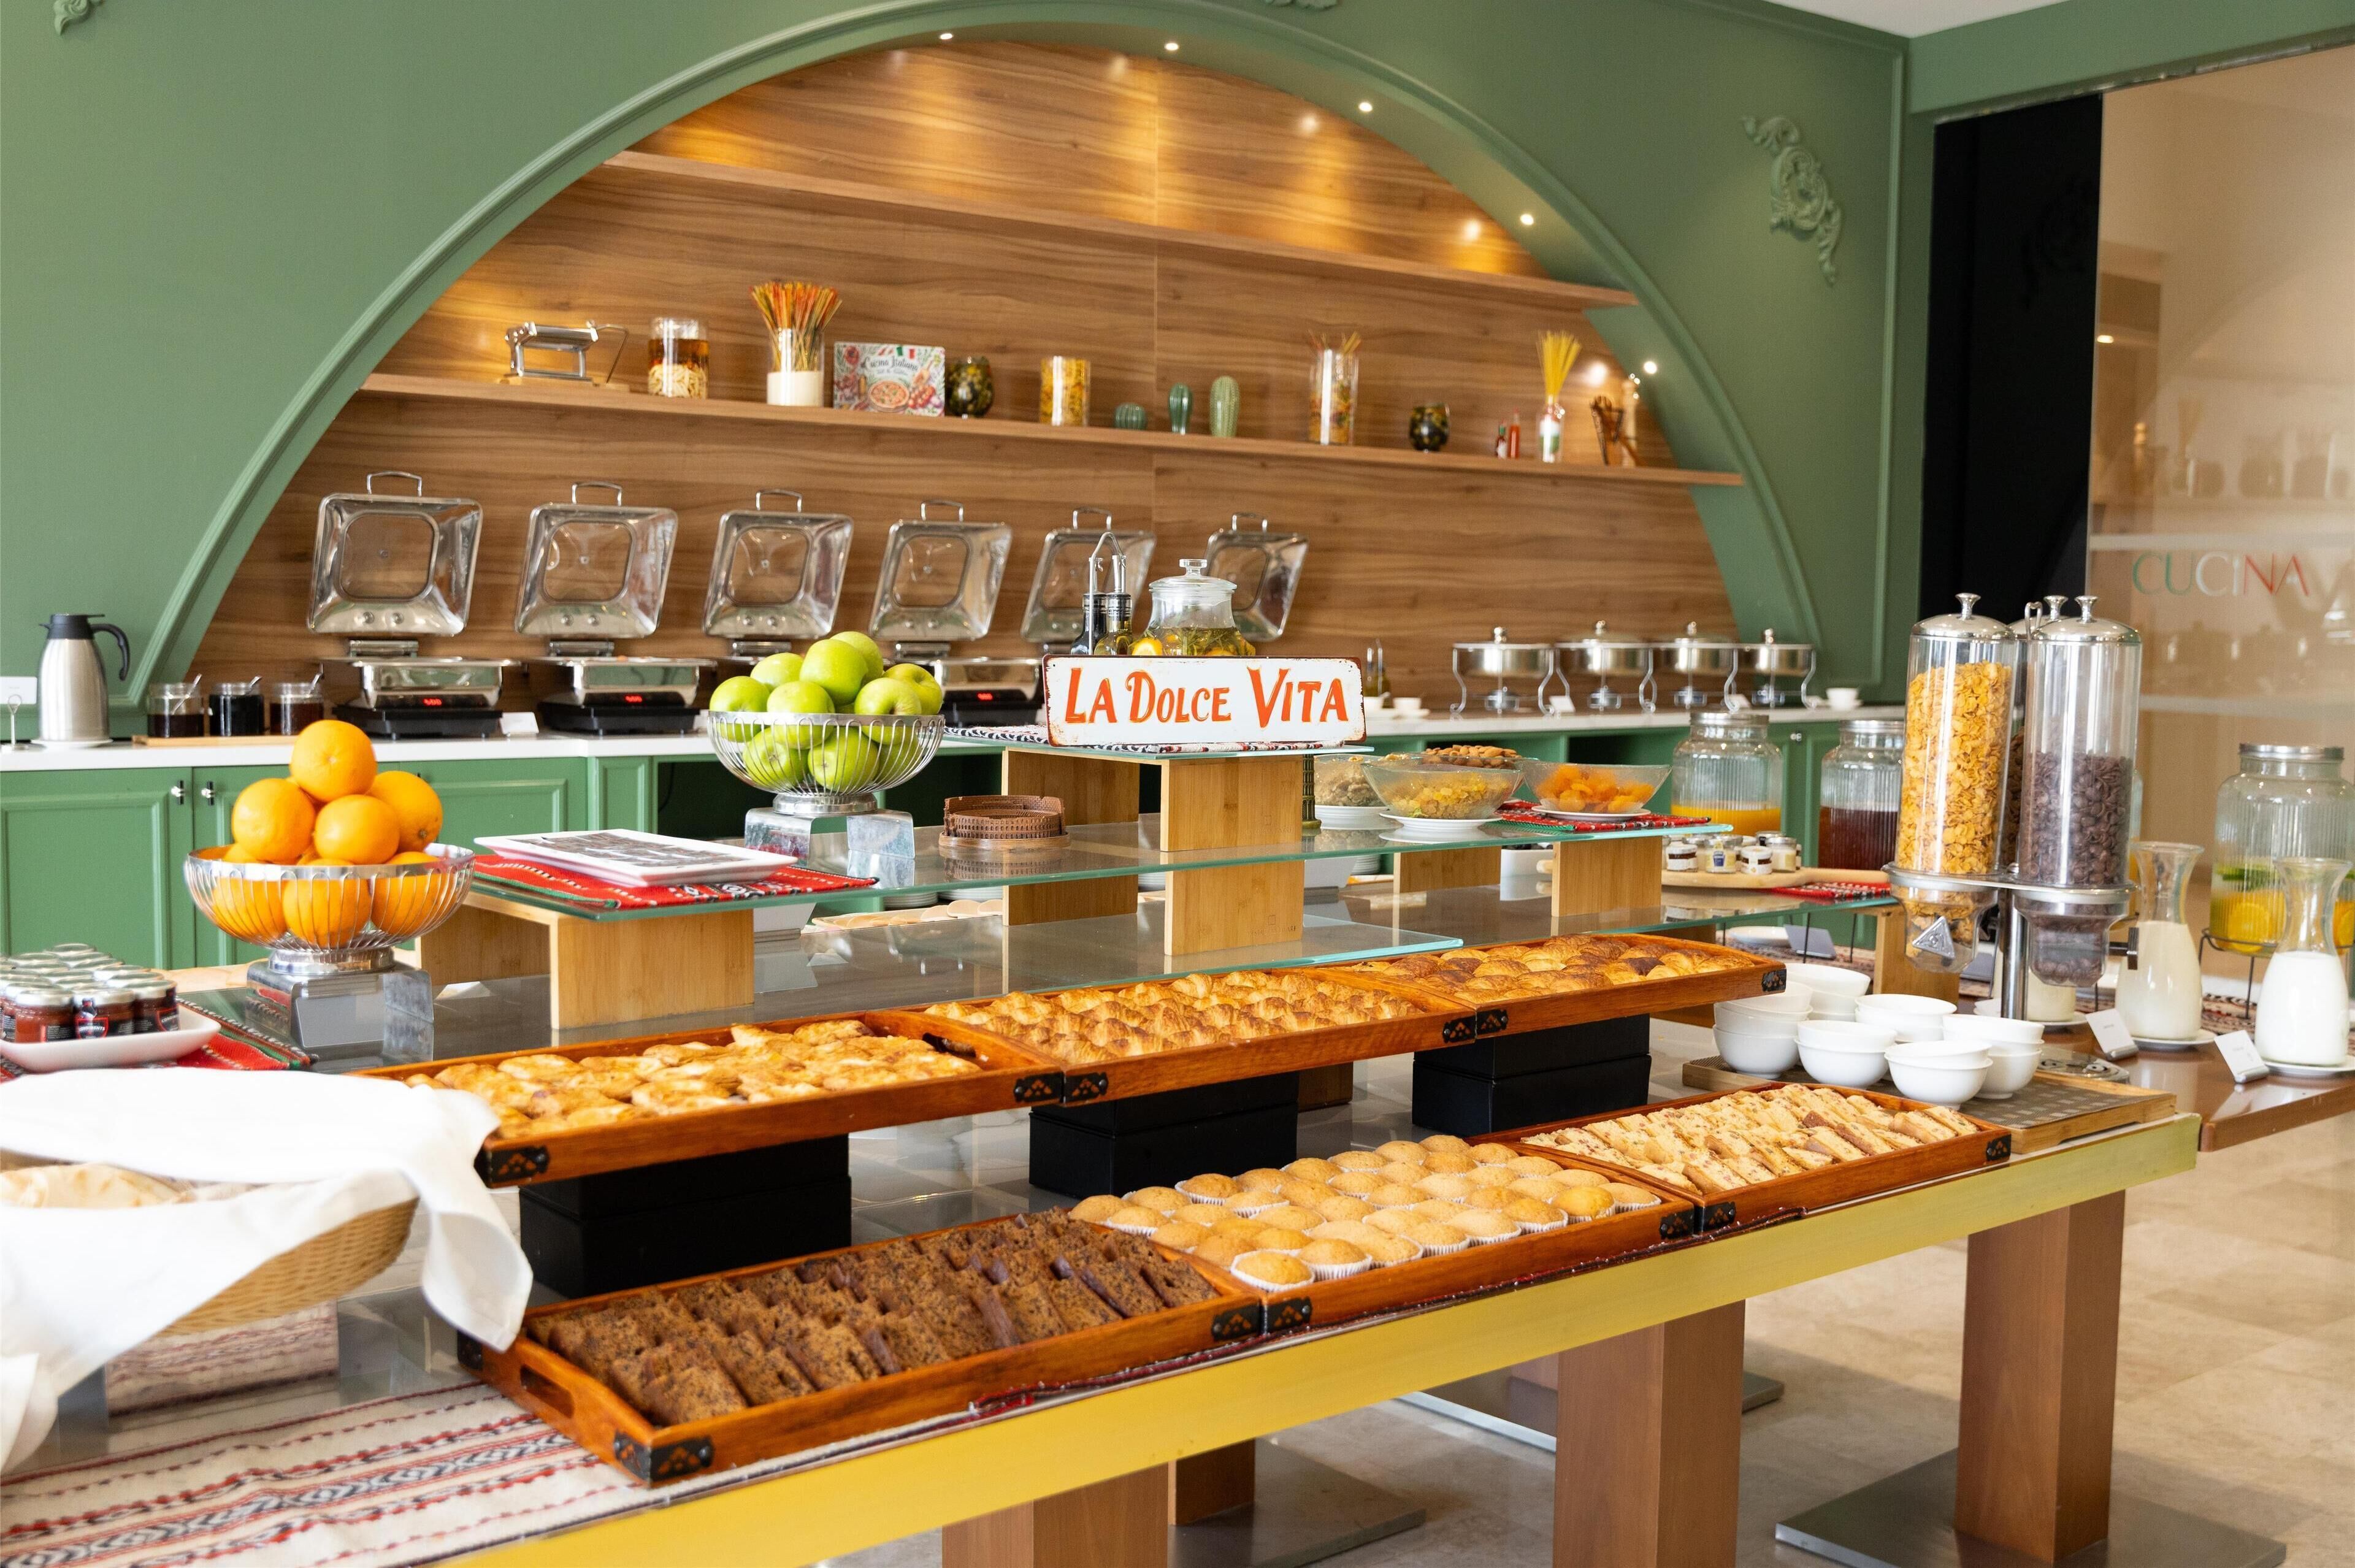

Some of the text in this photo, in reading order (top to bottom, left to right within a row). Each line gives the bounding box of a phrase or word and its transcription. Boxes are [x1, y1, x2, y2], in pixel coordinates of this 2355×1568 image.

[2132, 552, 2311, 597] CUCINA
[1065, 665, 1349, 729] LA DOLCE VITA
